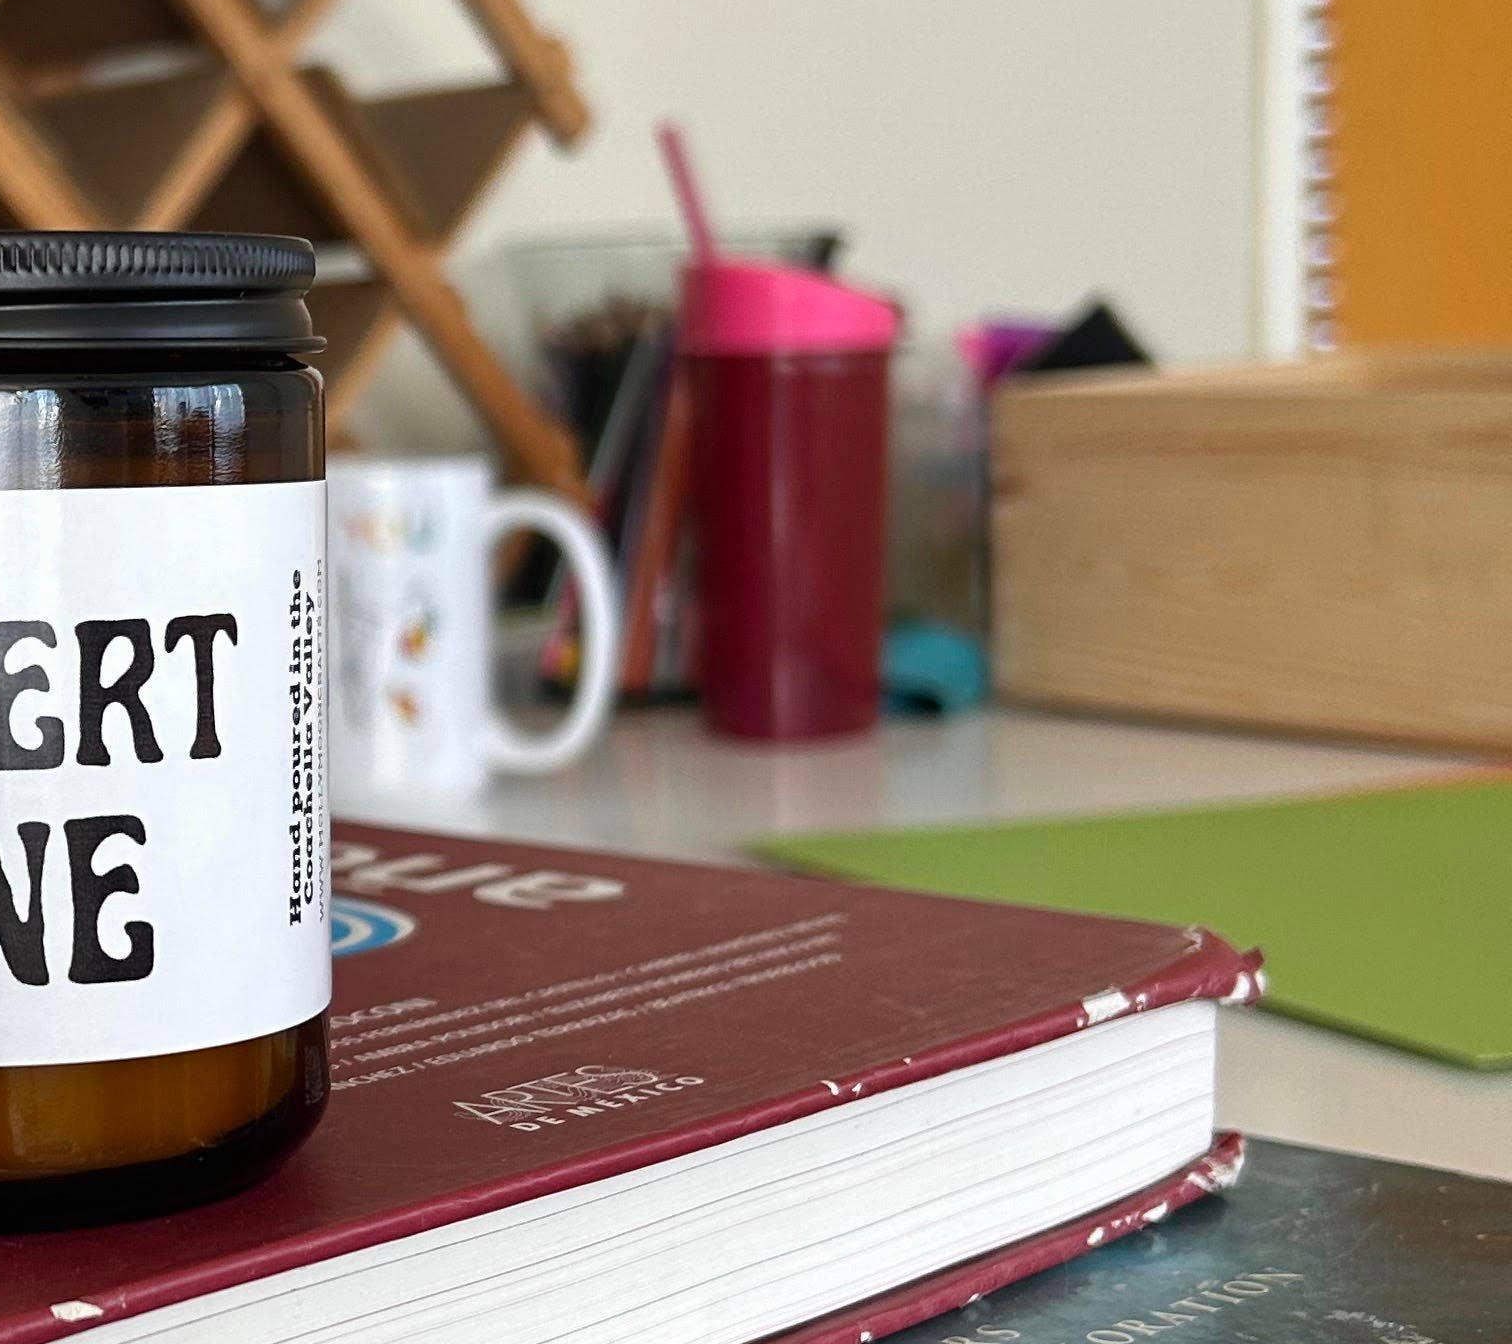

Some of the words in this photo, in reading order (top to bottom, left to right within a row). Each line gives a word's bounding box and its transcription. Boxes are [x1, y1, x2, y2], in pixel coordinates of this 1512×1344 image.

[289, 569, 301, 629] the
[289, 636, 301, 674] in
[303, 591, 315, 716] Valley
[289, 682, 303, 813] poured
[303, 722, 313, 905] Coachella
[289, 821, 301, 926] Hand
[452, 1065, 660, 1125] ARTES
[510, 1115, 565, 1132] DE
